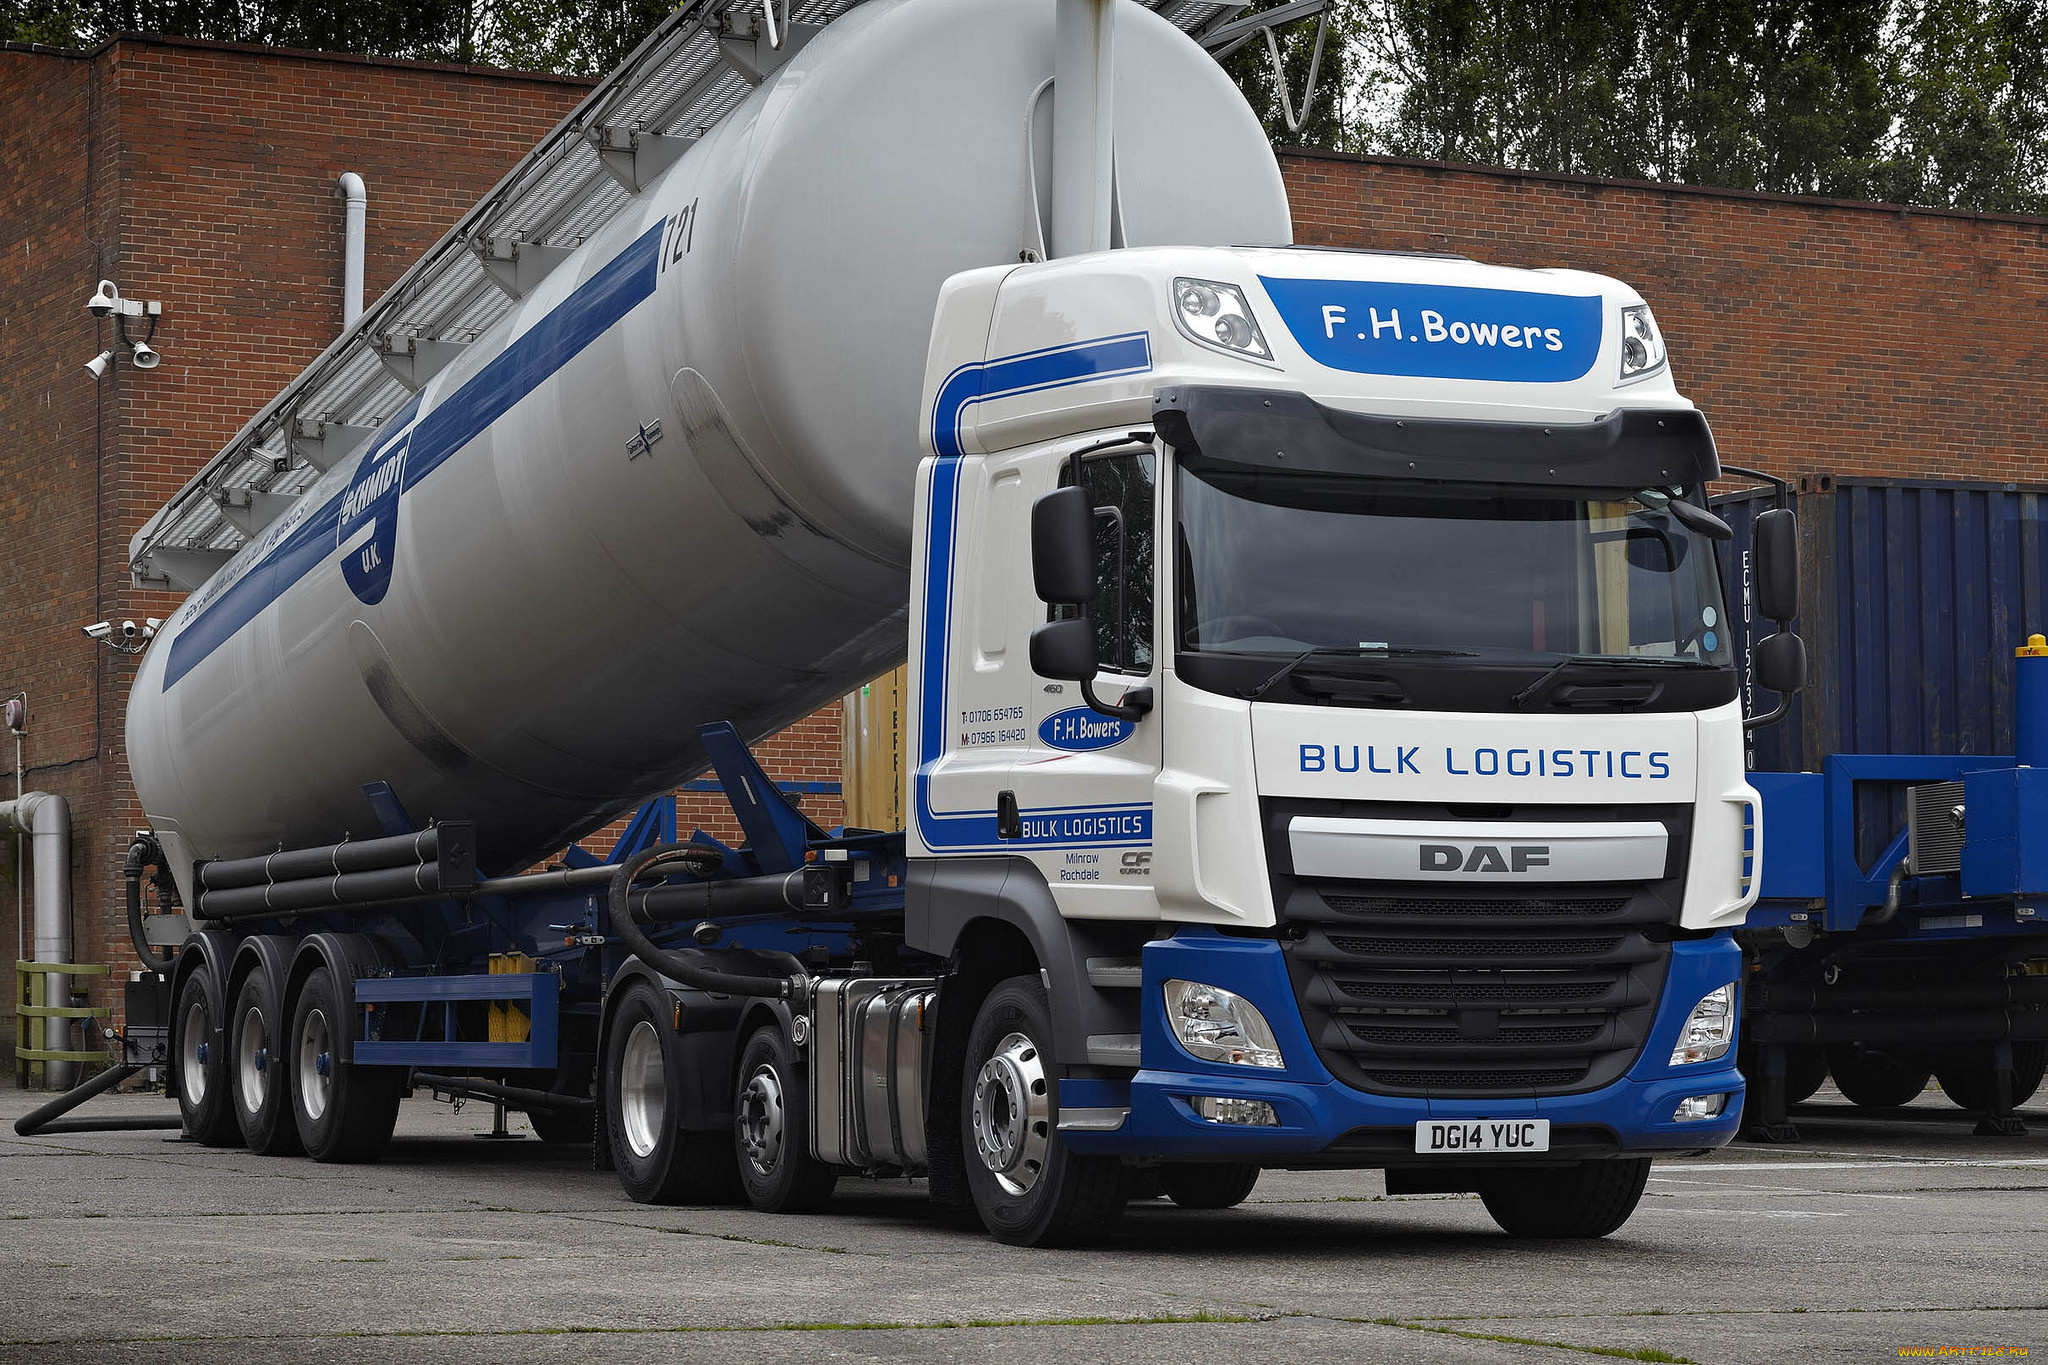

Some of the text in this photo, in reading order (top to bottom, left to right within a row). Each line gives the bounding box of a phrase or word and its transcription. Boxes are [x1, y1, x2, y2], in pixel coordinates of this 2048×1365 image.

[661, 196, 699, 274] 721
[341, 446, 407, 526] SCHMIDT
[361, 541, 382, 574] U.K.
[1742, 550, 1751, 623] ECMU
[1043, 684, 1064, 694] 460
[969, 709, 992, 723] 01706
[993, 707, 1024, 721] 654765
[971, 731, 996, 744] 07966
[998, 728, 1026, 743] 164420
[1053, 716, 1121, 741] F.H.Bowers
[1298, 743, 1671, 780] BULK LOGISTICS
[1022, 815, 1142, 839] BULK LOGISTICS
[1065, 853, 1100, 865] Milnrow
[1121, 851, 1153, 867] CF
[1418, 843, 1551, 874] DAF
[1060, 869, 1100, 881] Rochdale
[1430, 1123, 1535, 1149] DG14 YUC
